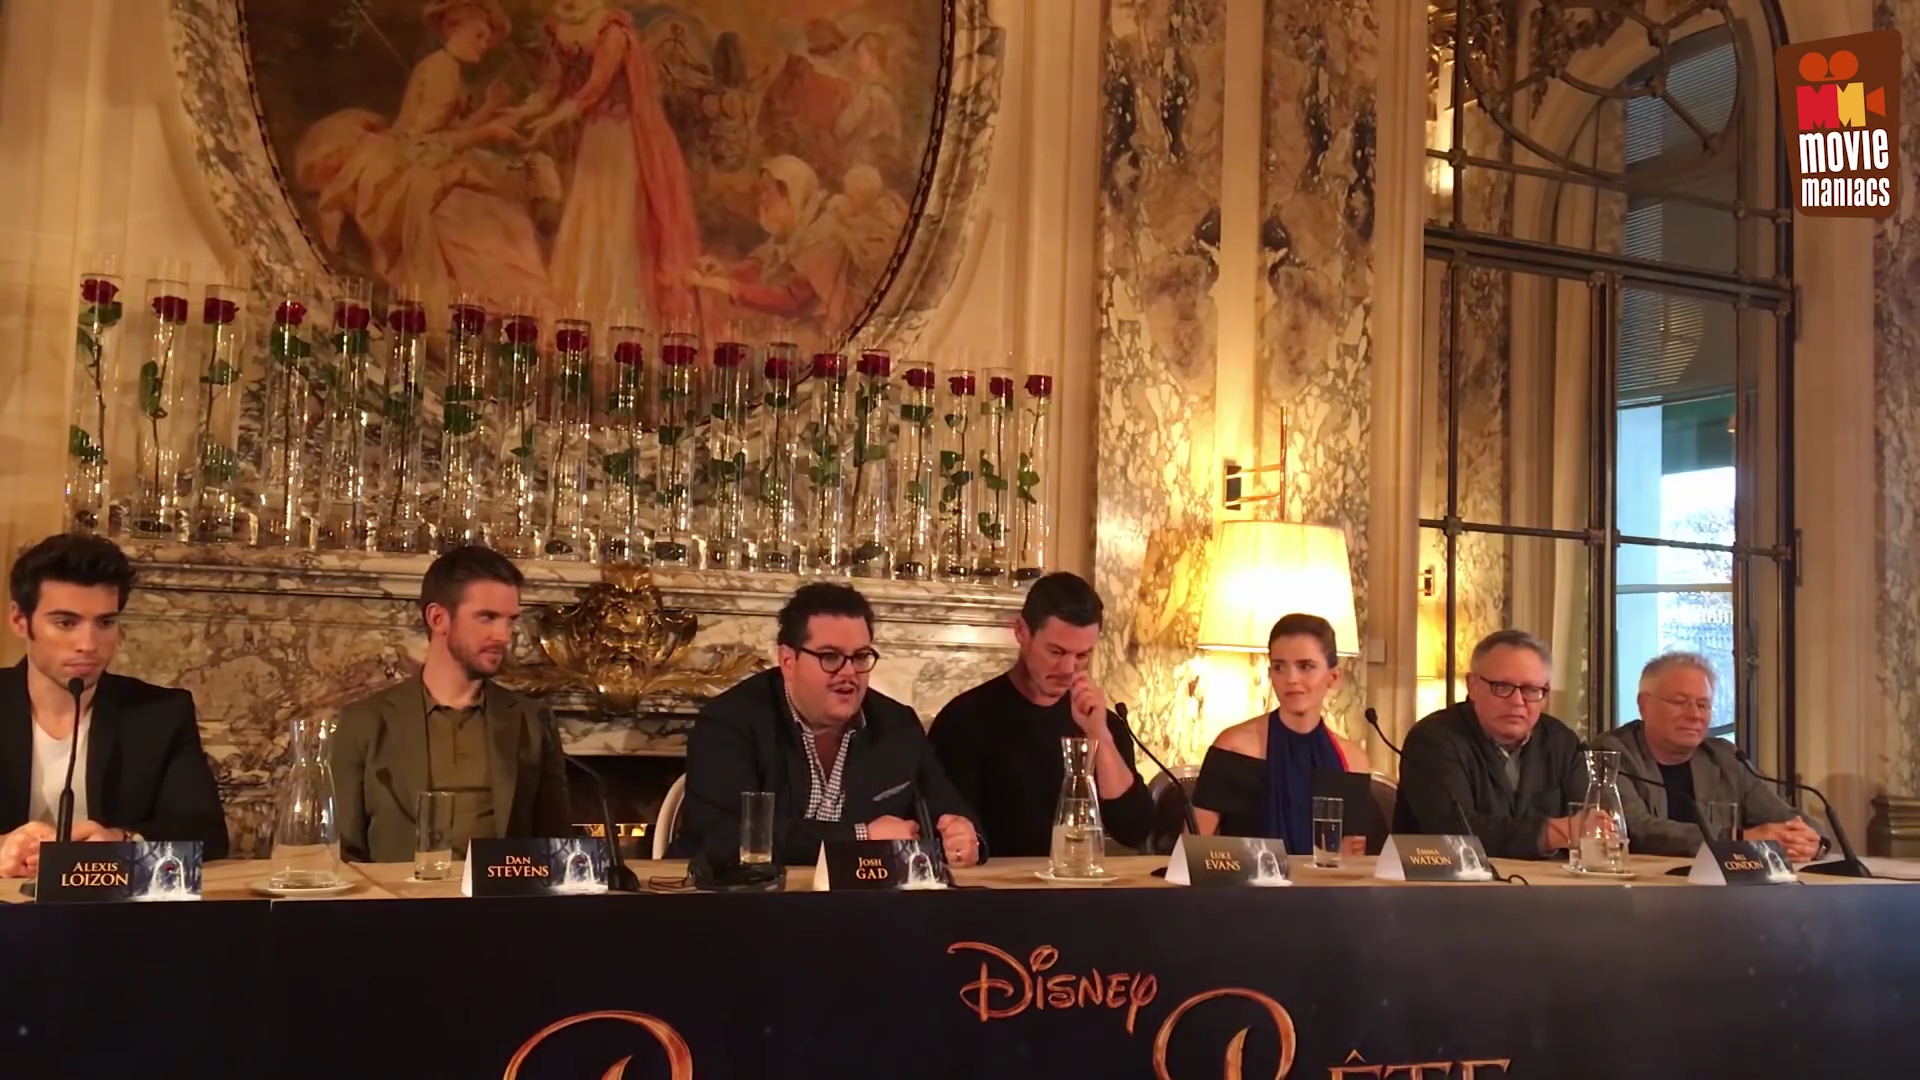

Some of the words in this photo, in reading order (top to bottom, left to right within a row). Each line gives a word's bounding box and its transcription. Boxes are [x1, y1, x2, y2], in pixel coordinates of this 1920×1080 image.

[505, 855, 531, 865] DAN
[1210, 850, 1231, 859] LUKE
[858, 857, 882, 868] JOSH
[1205, 859, 1241, 871] EVANS
[1409, 855, 1452, 866] WATSON
[1724, 860, 1764, 871] CONDON
[72, 861, 119, 872] ALEXIS
[487, 865, 549, 878] STEVENS
[855, 867, 889, 880] GAD
[60, 872, 129, 887] LOIZON
